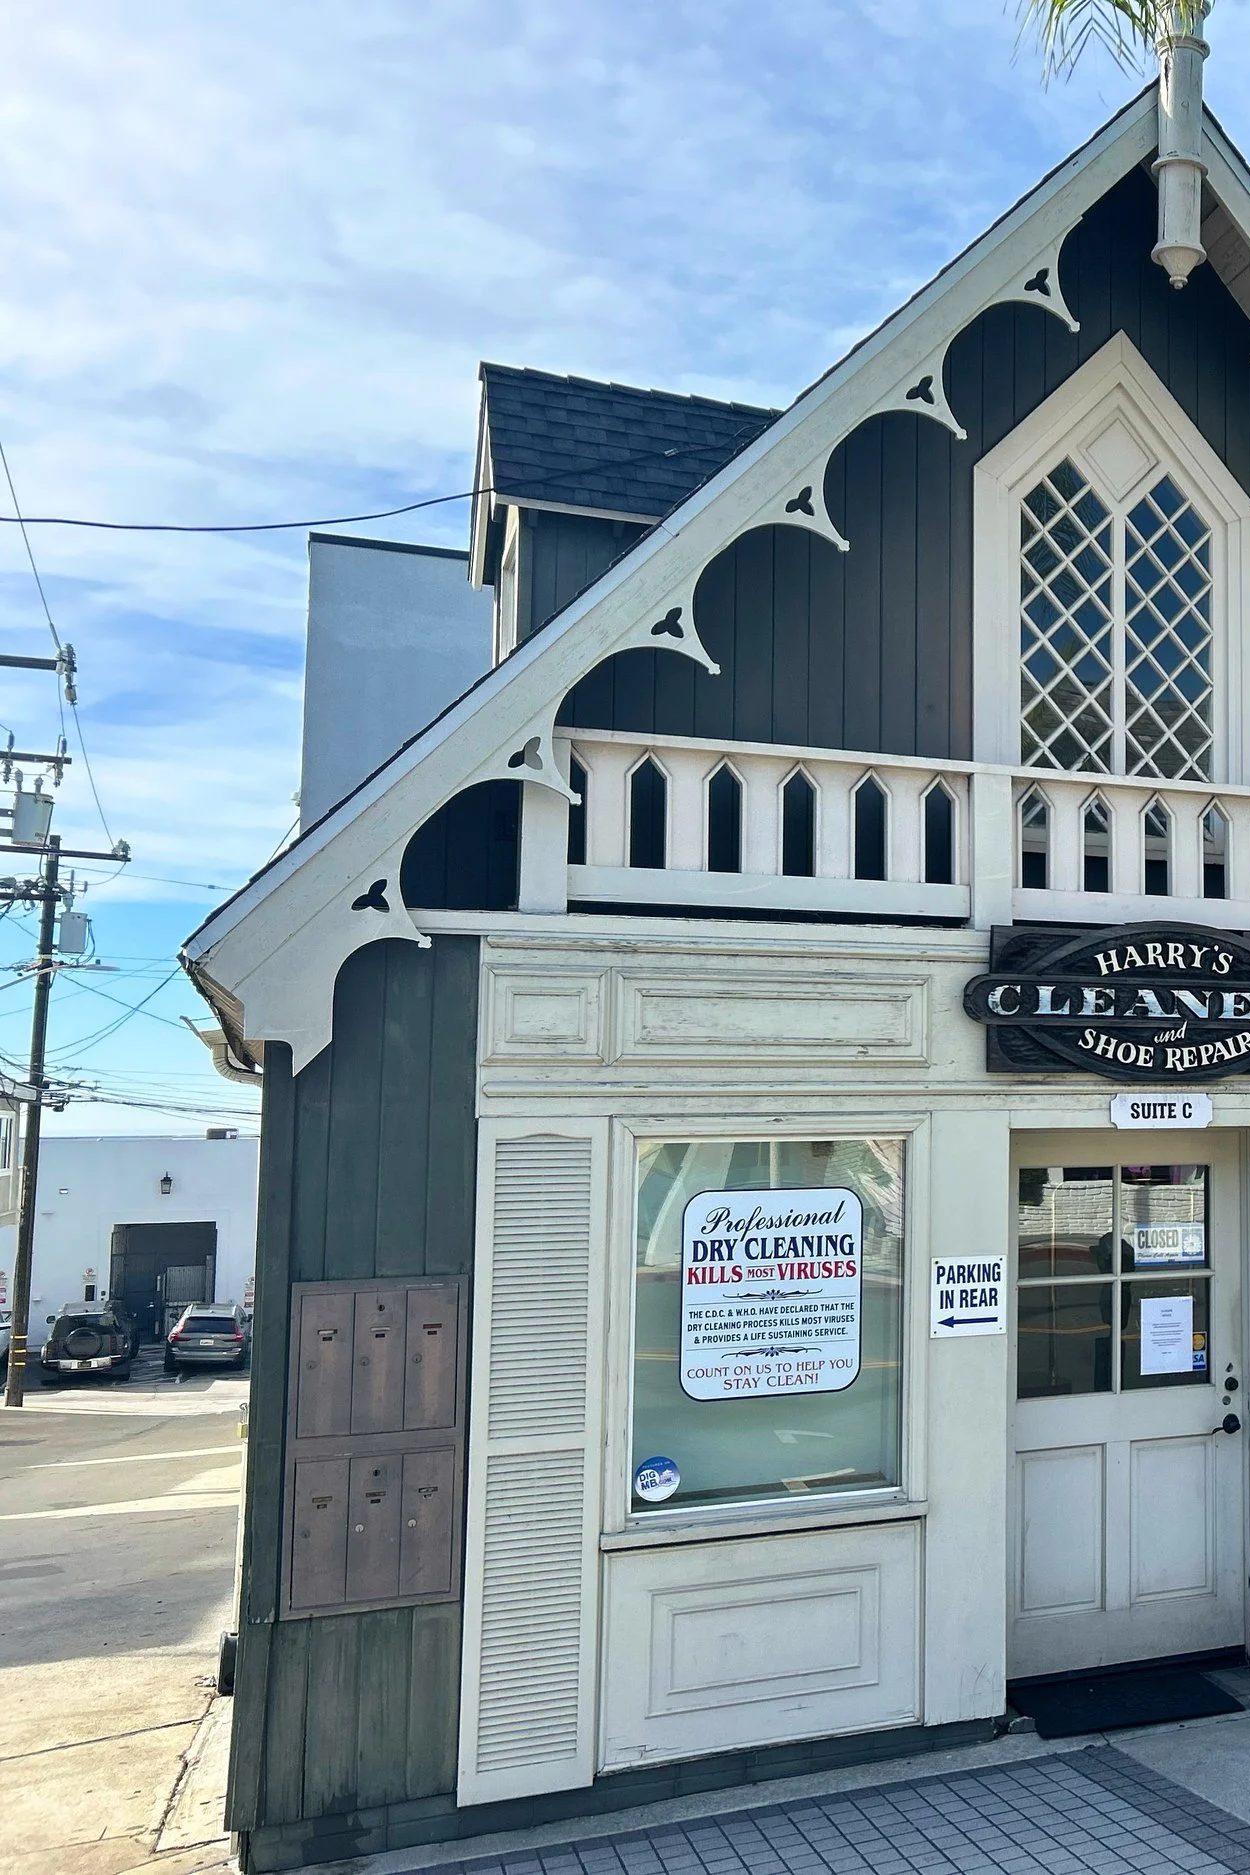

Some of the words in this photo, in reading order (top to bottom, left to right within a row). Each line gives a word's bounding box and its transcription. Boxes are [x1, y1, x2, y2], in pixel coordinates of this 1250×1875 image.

[1094, 942, 1234, 976] HARRY'S
[1154, 1020, 1188, 1043] and
[1078, 1028, 1154, 1068] SHOE
[1130, 1102, 1178, 1120] SUITE
[1182, 1102, 1193, 1119] C
[700, 1200, 845, 1241] Professional
[692, 1238, 737, 1262] DRY
[744, 1234, 854, 1261] CLEANING
[1138, 1229, 1179, 1249] CLOSED
[687, 1265, 743, 1285] KILLS
[747, 1267, 775, 1279] MOST
[777, 1260, 857, 1281] VIRUSES
[936, 1262, 1001, 1285] PARKING
[940, 1289, 955, 1309] IN
[959, 1287, 998, 1308] REAR
[689, 1311, 703, 1319] THE
[705, 1310, 725, 1318] C.D.C.
[727, 1309, 733, 1317] &
[736, 1308, 757, 1317] W.H.O.
[759, 1306, 778, 1315] HAVE
[780, 1304, 819, 1314] DECLARED
[821, 1303, 839, 1311] THAT
[841, 1302, 855, 1310] THE
[687, 1323, 703, 1332] DRY
[704, 1321, 742, 1331] CLEANING
[743, 1318, 778, 1329] PROCESS
[779, 1317, 800, 1326] KILLS
[801, 1316, 822, 1325] MOST
[824, 1314, 855, 1324] VIRUSES
[702, 1334, 741, 1344] PROVIDES
[742, 1333, 749, 1341] A
[750, 1332, 766, 1340] LIFE
[768, 1329, 813, 1339] SUSTAINING
[814, 1327, 848, 1337] SERVICE.
[687, 1367, 729, 1379] COUNT
[733, 1365, 751, 1376] ON
[756, 1364, 771, 1374] US
[776, 1362, 792, 1373] TO
[796, 1360, 825, 1372] HELP
[829, 1358, 853, 1369] YOU
[723, 1377, 763, 1390] STAY
[766, 1373, 819, 1387] CLEAN!
[640, 1470, 656, 1482] DIG
